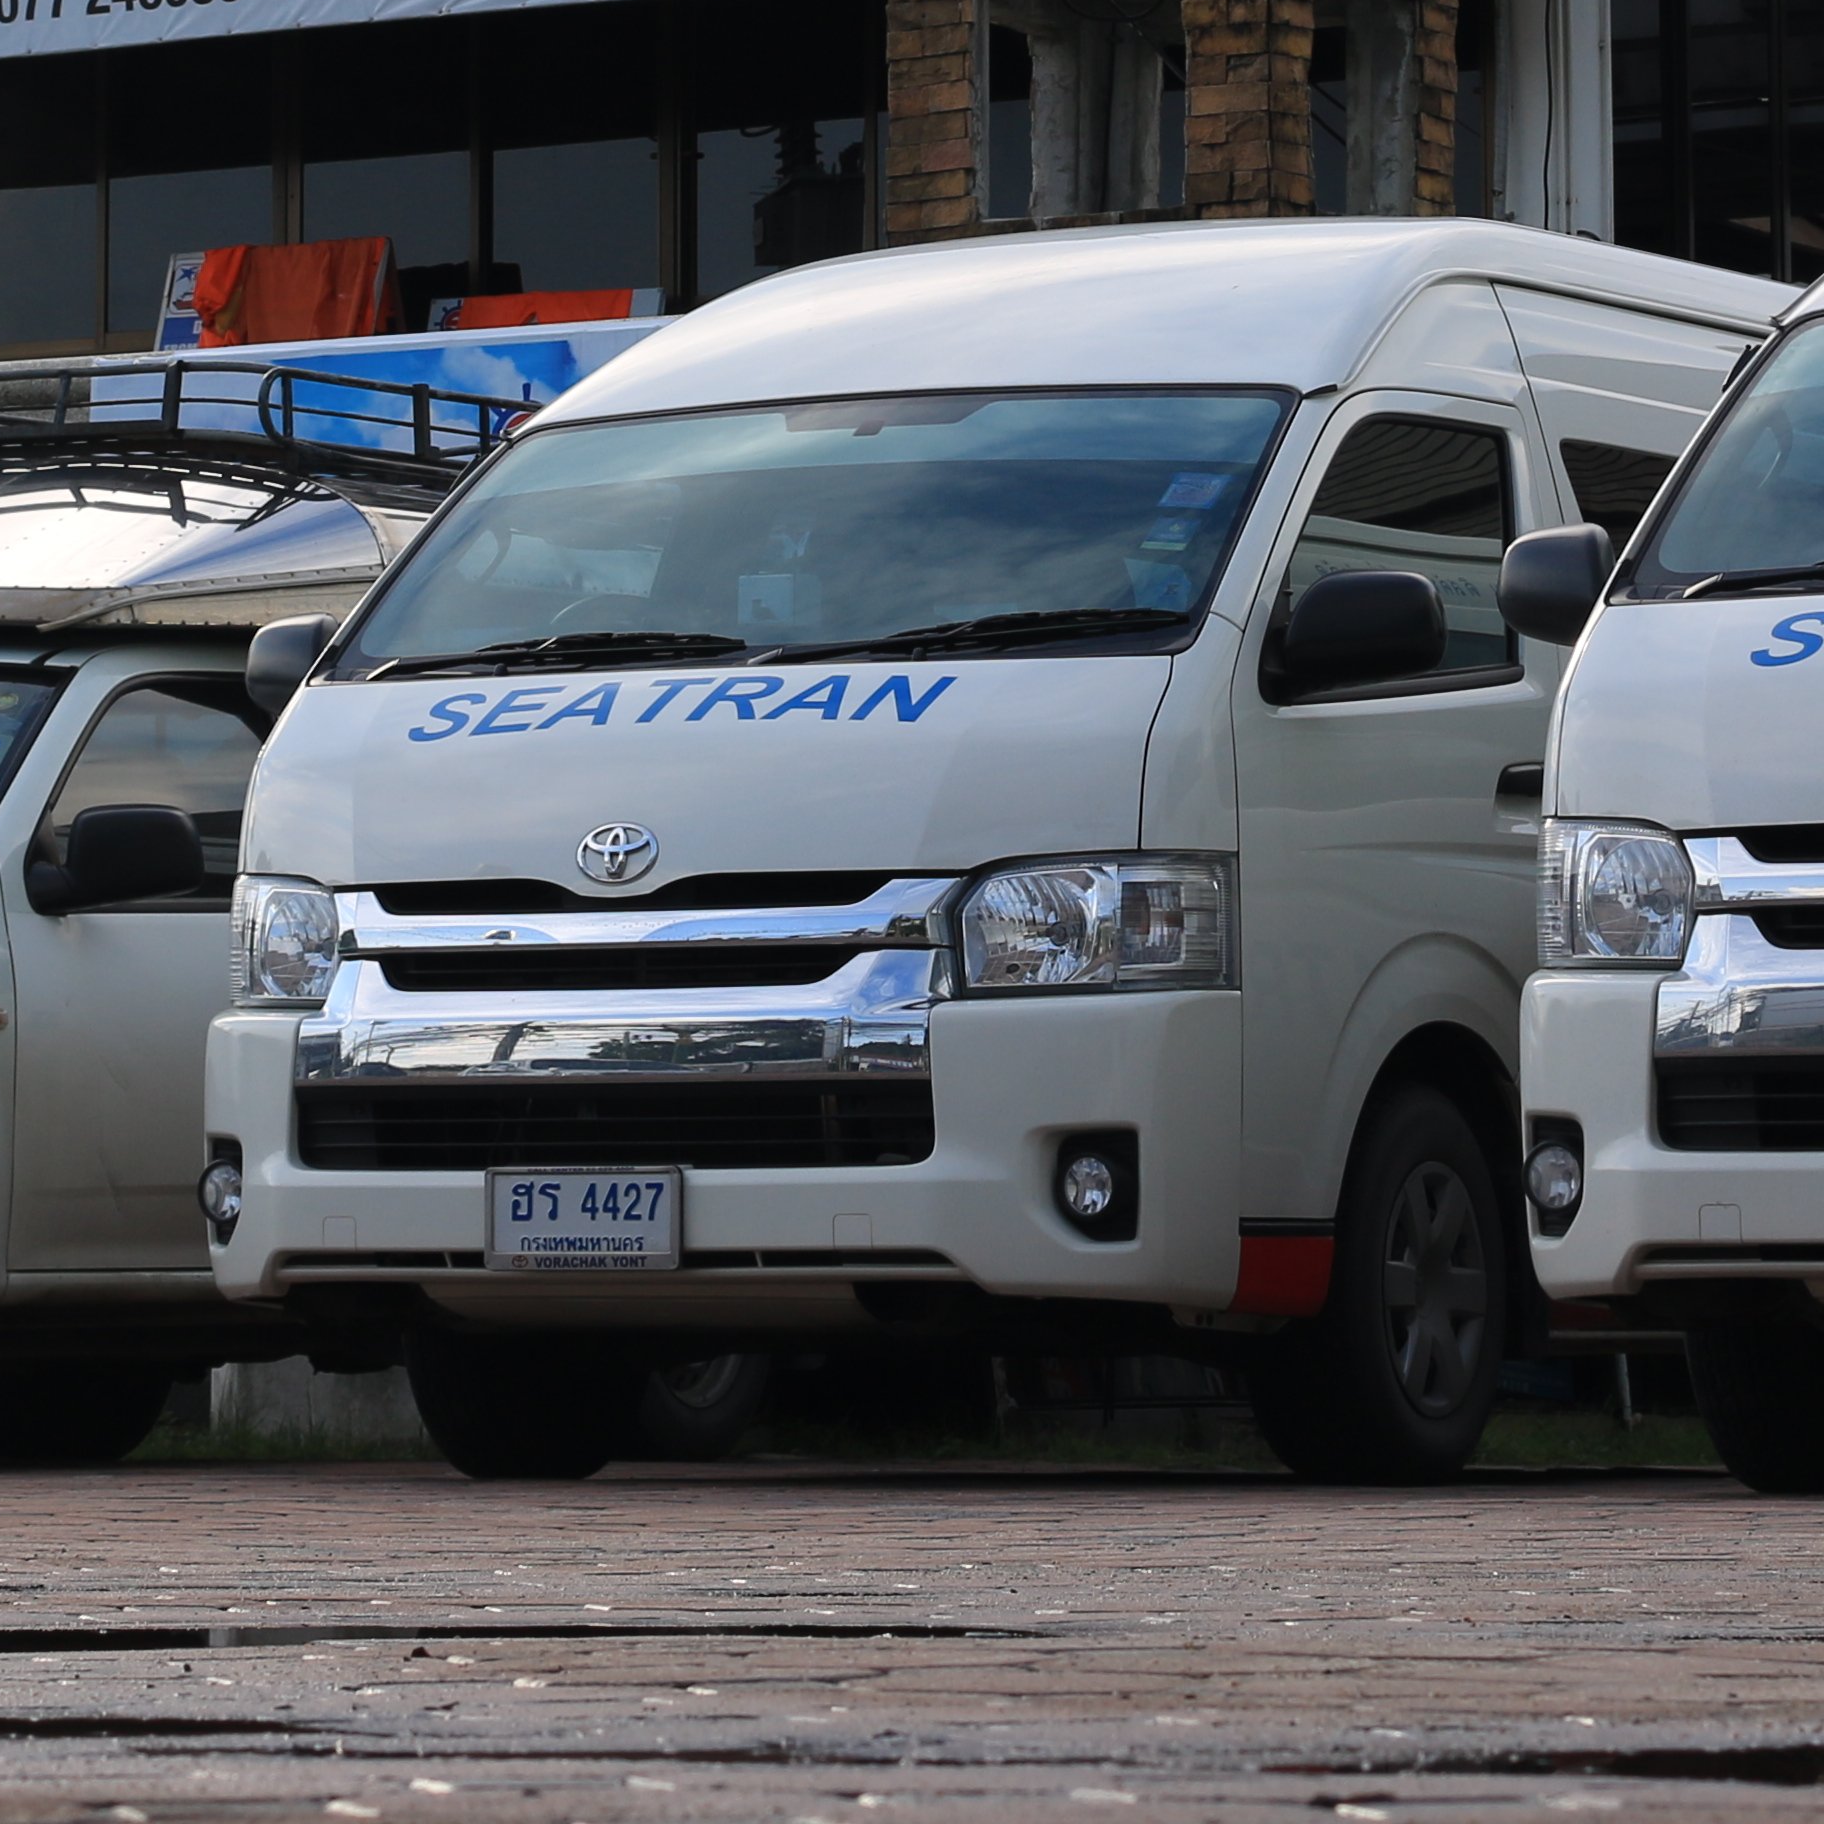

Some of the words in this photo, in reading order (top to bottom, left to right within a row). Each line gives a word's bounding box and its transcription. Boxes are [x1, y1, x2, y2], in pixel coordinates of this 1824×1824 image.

[408, 675, 958, 742] SEATRAN
[511, 1181, 561, 1222] ฮร
[581, 1182, 664, 1222] 4427
[520, 1236, 644, 1252] กรงเทพมหานคร
[535, 1256, 607, 1268] VORACHAK
[611, 1256, 647, 1268] YONT
